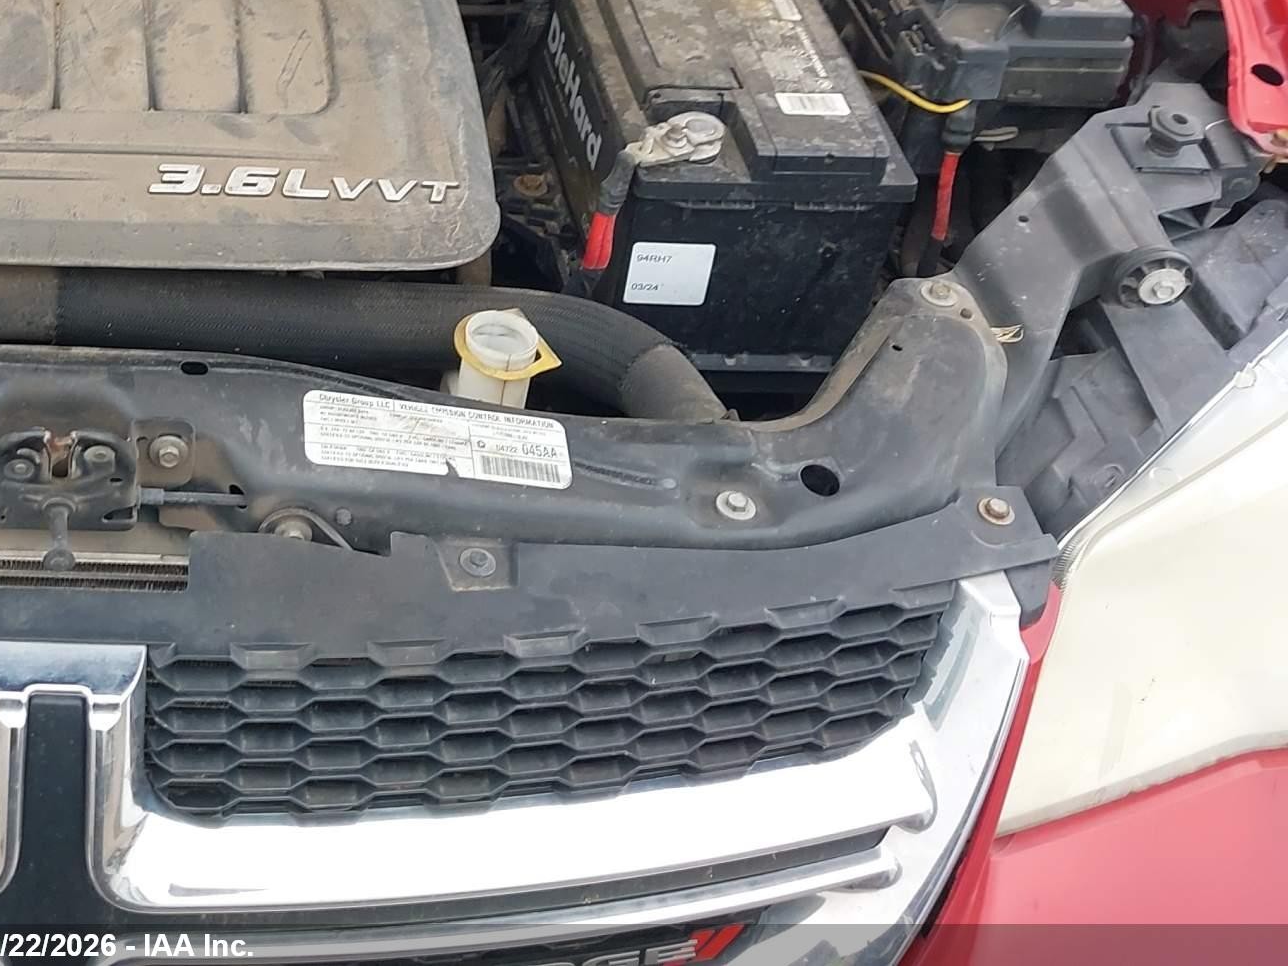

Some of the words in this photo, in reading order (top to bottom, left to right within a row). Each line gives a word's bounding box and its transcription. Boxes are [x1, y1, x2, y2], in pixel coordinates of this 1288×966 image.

[546, 14, 603, 171] DieHard
[636, 254, 673, 264] 94RH7
[631, 282, 659, 291] 03/24
[319, 393, 349, 404] Chrysler
[351, 396, 374, 407] Group
[376, 399, 390, 409] LLC
[468, 411, 501, 422] CONTROL
[503, 415, 555, 429] INFORMATION
